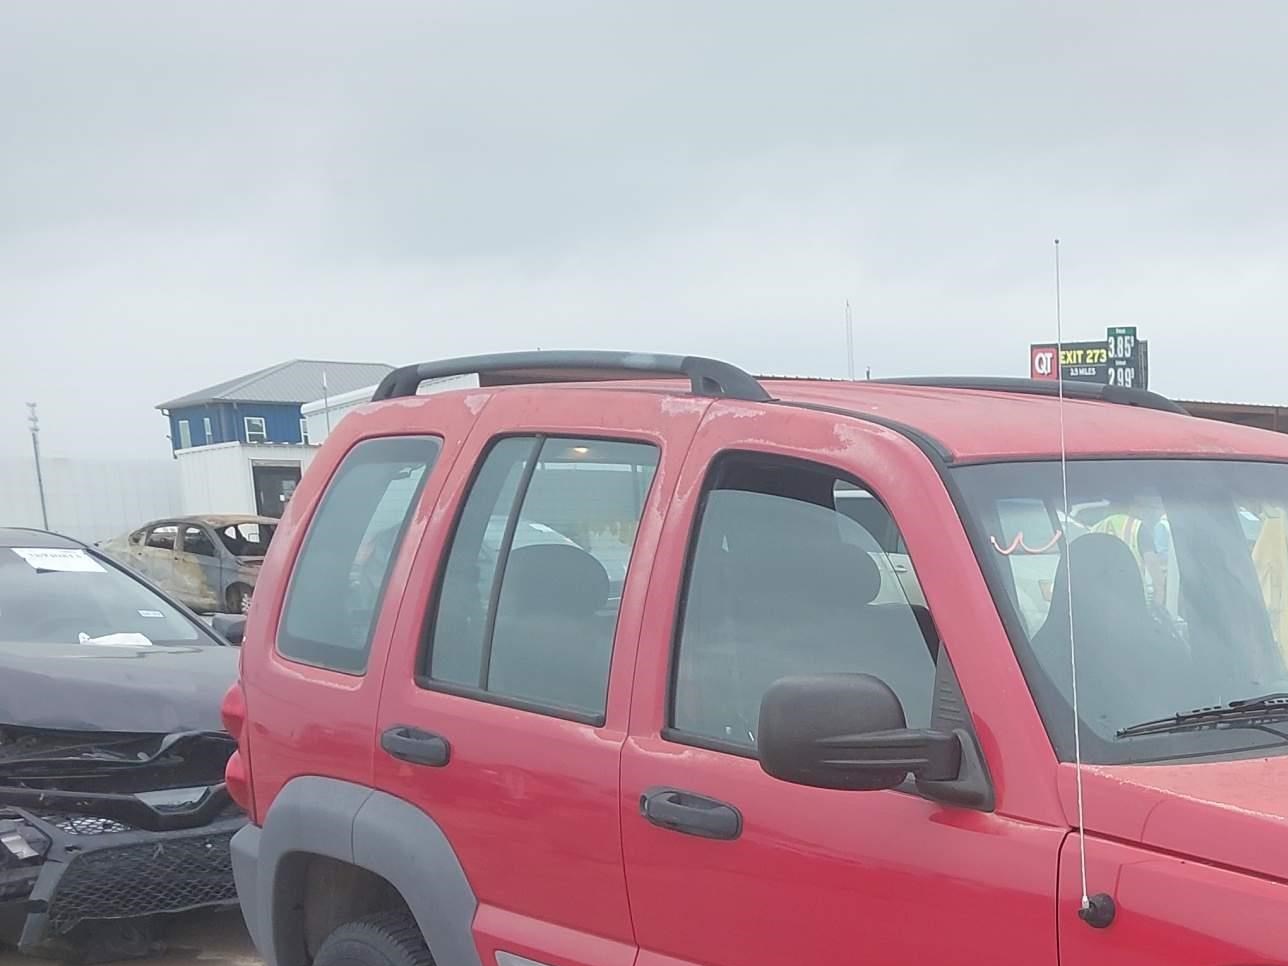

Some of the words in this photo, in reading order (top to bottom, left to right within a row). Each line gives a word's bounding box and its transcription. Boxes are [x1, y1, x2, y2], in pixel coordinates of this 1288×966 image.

[1035, 352, 1053, 375] QT
[1060, 350, 1084, 364] EXIT
[1086, 349, 1107, 363] 273
[1079, 367, 1096, 376] MILES
